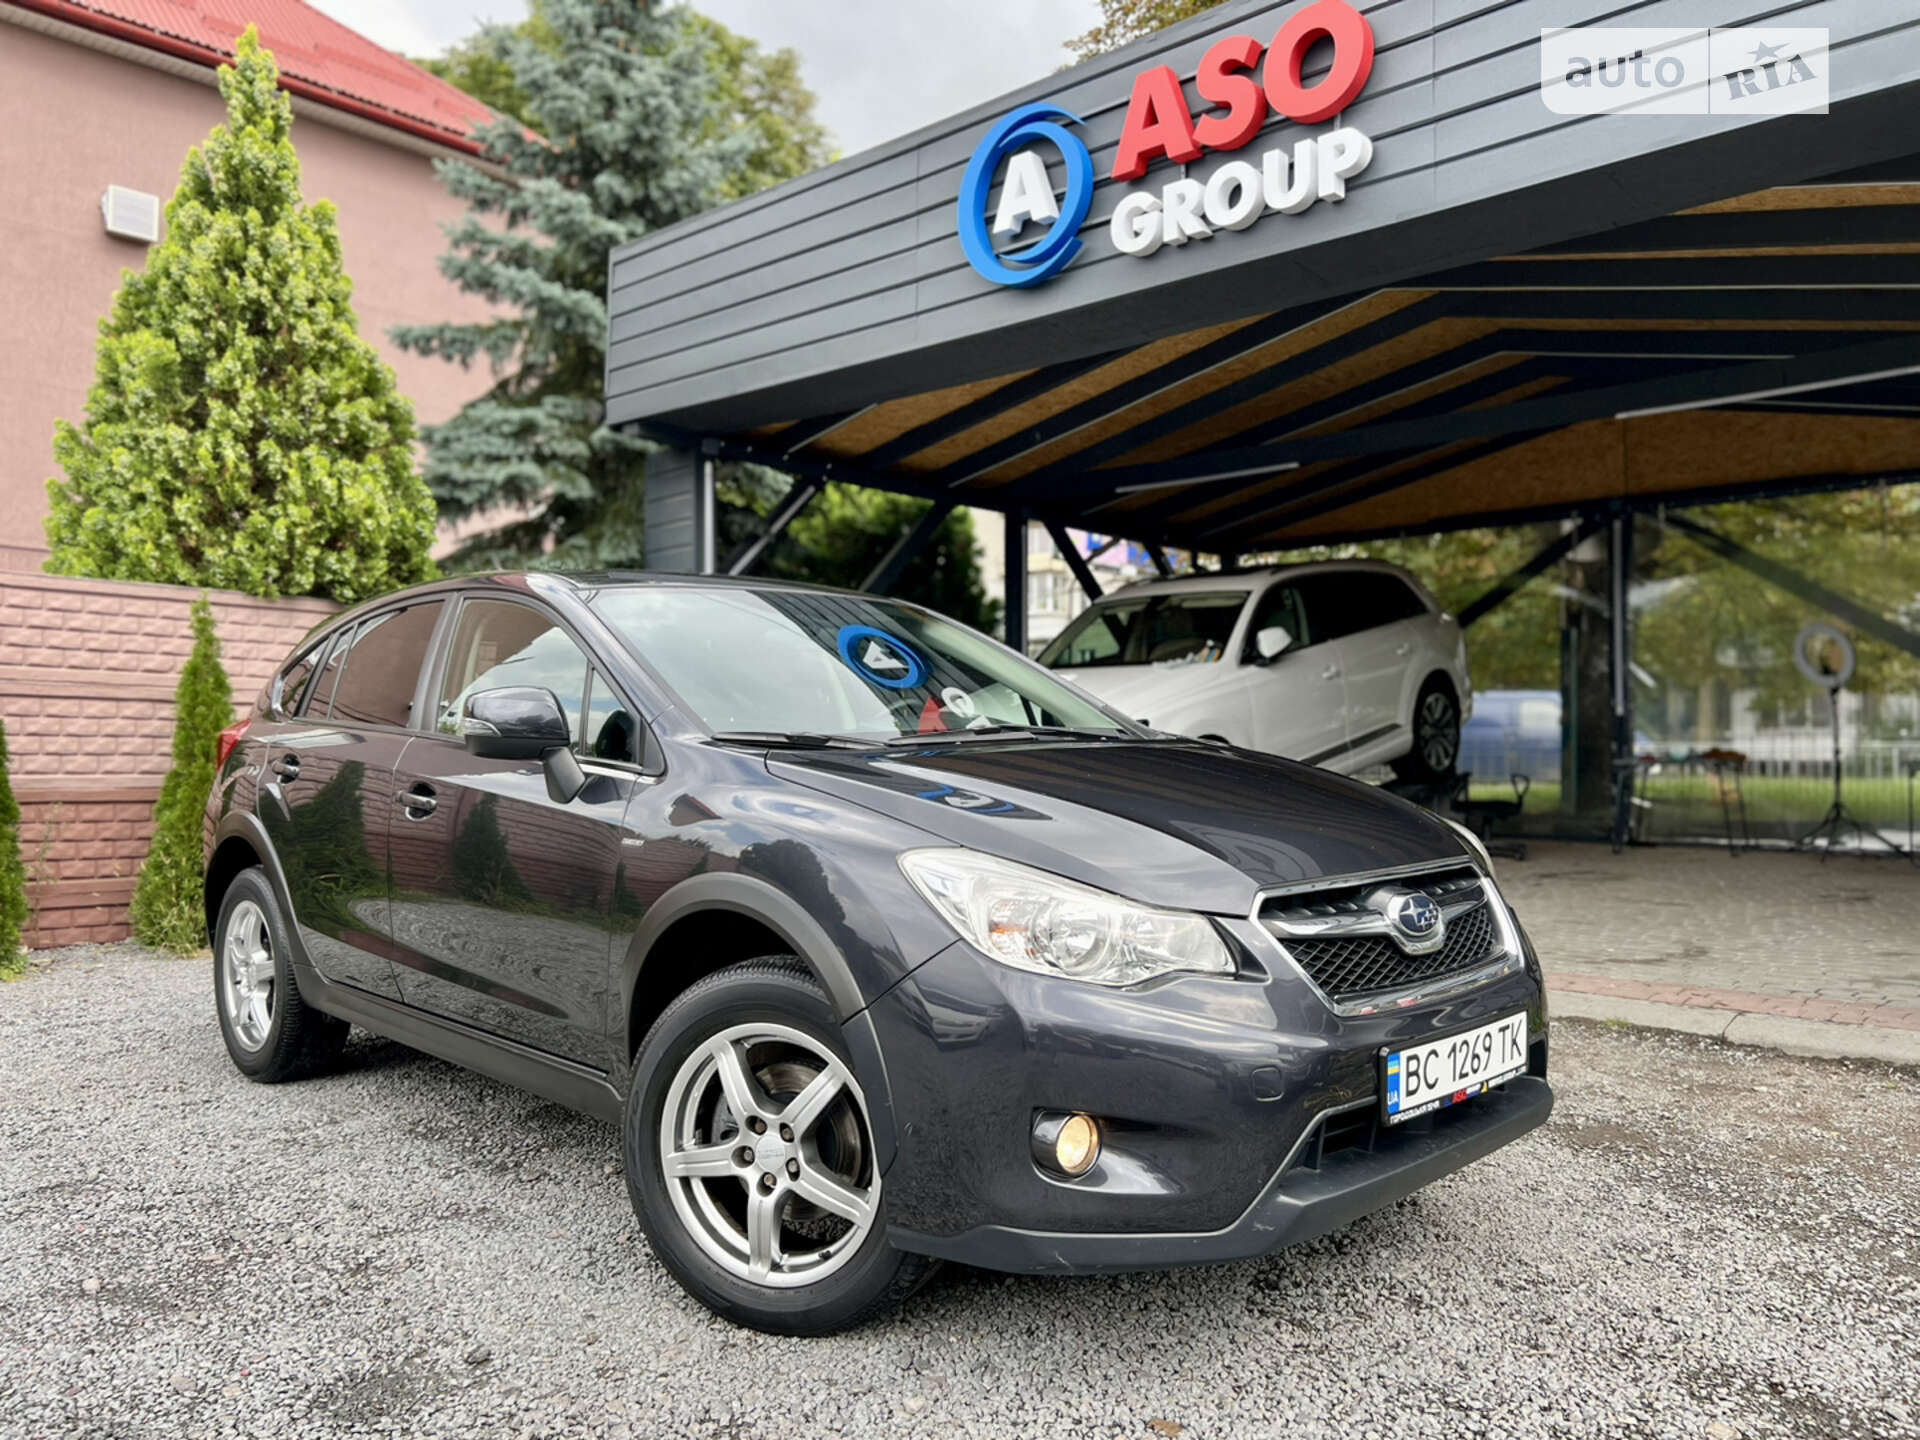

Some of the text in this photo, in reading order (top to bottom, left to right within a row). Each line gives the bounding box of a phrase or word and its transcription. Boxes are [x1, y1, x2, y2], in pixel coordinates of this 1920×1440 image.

[1112, 0, 1375, 182] ASO
[993, 150, 1060, 238] A
[1110, 127, 1373, 257] GROUP
[1387, 1090, 1399, 1105] UA
[1405, 1049, 1439, 1097] BC
[1448, 1032, 1493, 1082] 1269
[1498, 1020, 1523, 1064] TK
